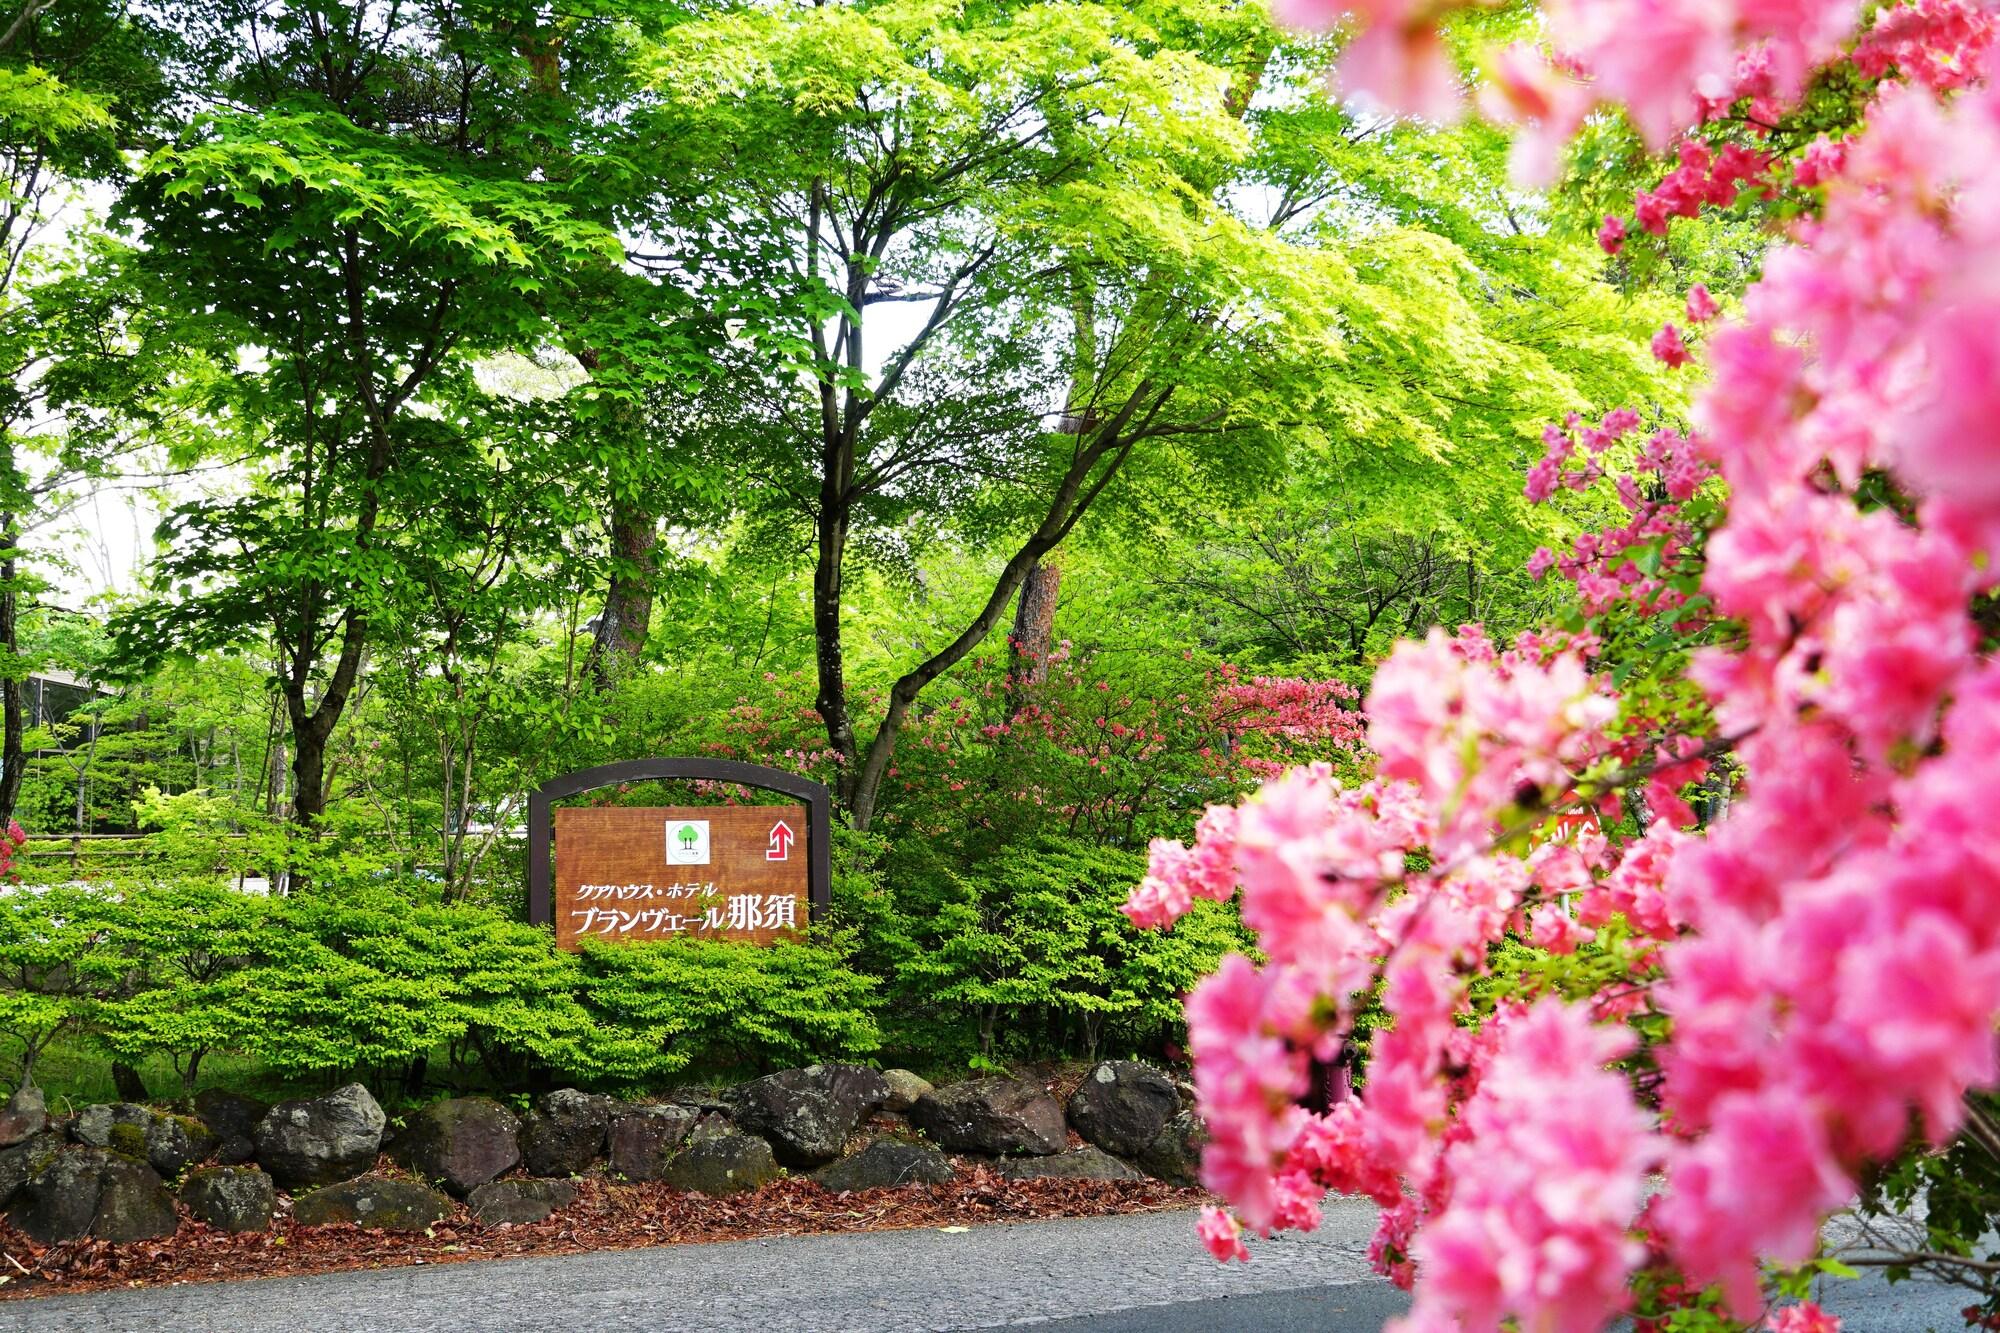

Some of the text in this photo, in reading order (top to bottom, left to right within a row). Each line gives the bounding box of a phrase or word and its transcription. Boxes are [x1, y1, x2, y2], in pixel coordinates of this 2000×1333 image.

[576, 882, 718, 901] クアハウス・ホテル
[571, 894, 796, 934] ブランヴェール那須
